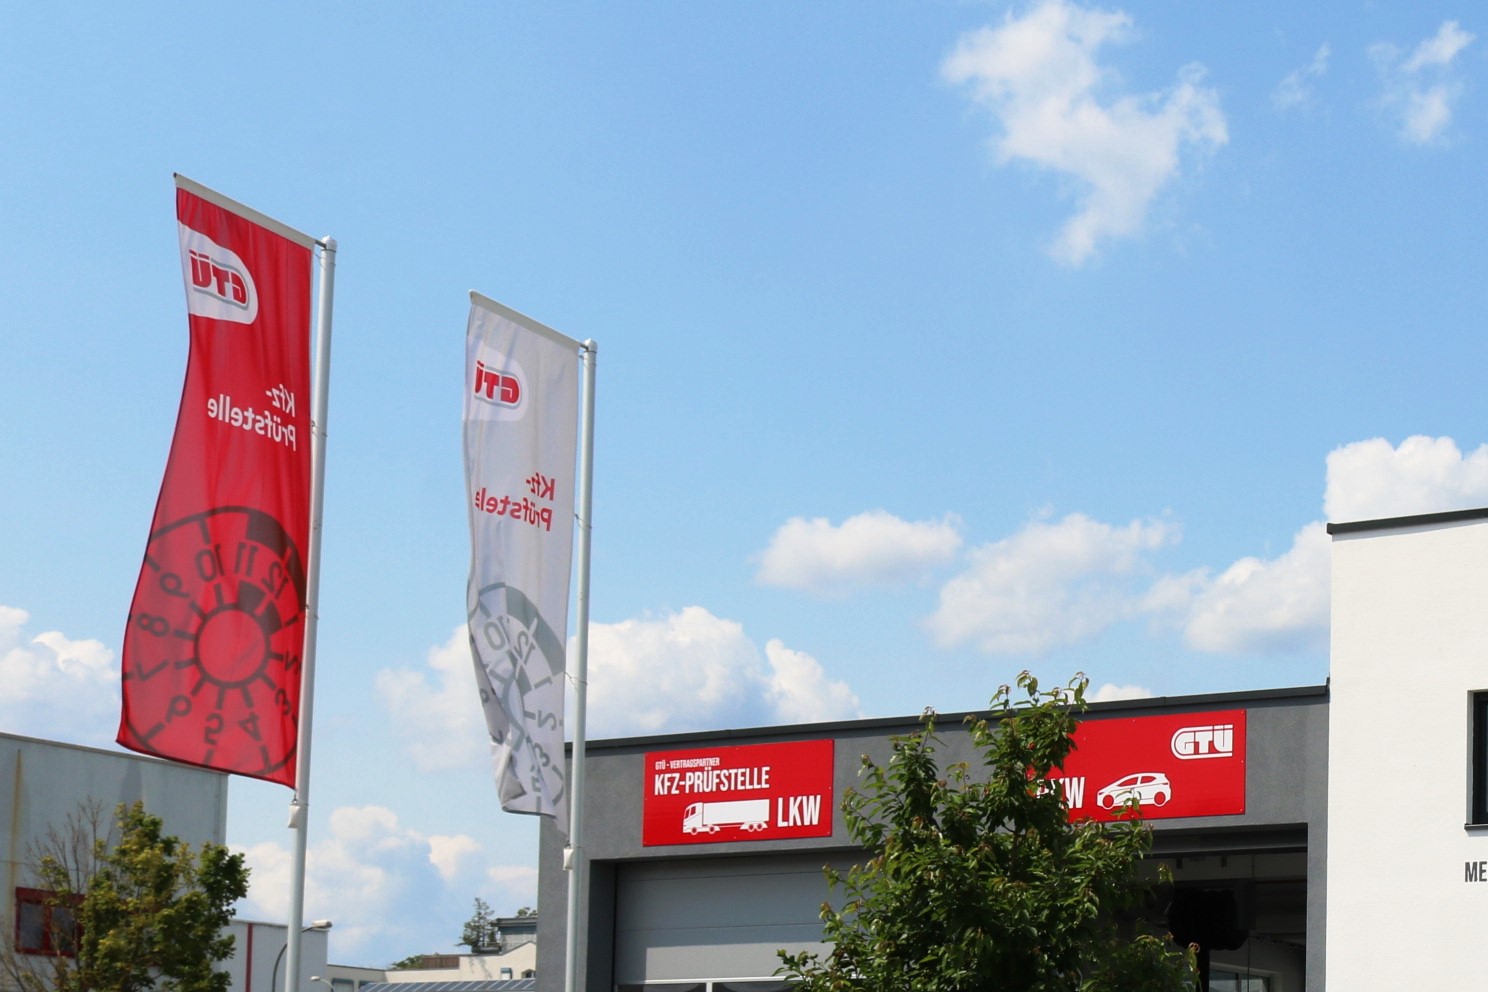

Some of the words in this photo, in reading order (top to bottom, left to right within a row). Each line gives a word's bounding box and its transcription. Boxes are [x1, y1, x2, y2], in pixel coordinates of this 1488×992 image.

[1175, 724, 1233, 755] GTÜ
[655, 759, 666, 770] GTÜ
[669, 757, 720, 770] VERTRAGSPARTNER
[654, 766, 770, 796] KFZ-PRÜFSTELLE
[777, 794, 821, 828] LKW
